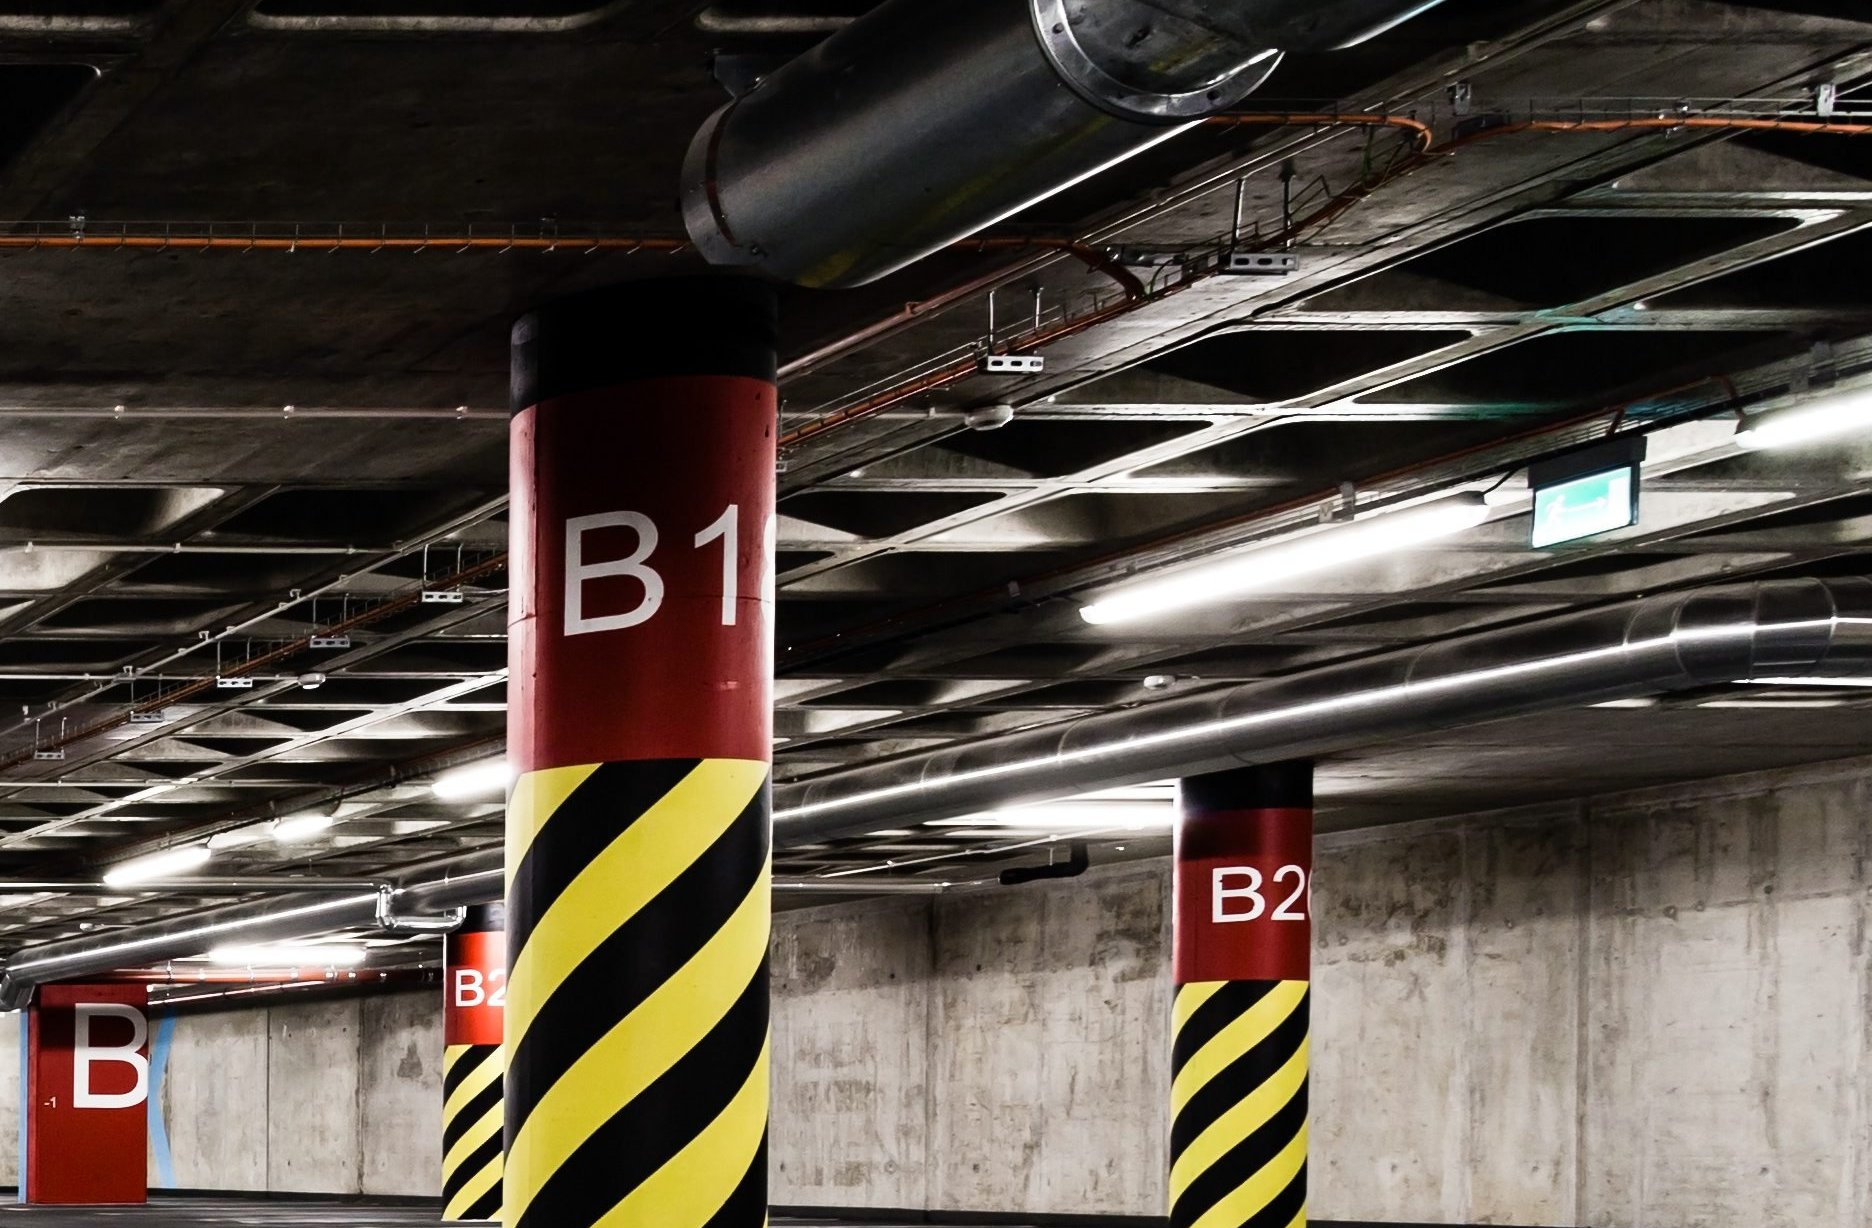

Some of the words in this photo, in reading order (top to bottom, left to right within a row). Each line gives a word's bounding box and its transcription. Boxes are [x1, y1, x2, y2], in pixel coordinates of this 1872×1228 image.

[1212, 864, 1312, 924] B2
[73, 1003, 148, 1109] B
[44, 1096, 56, 1108] -1
